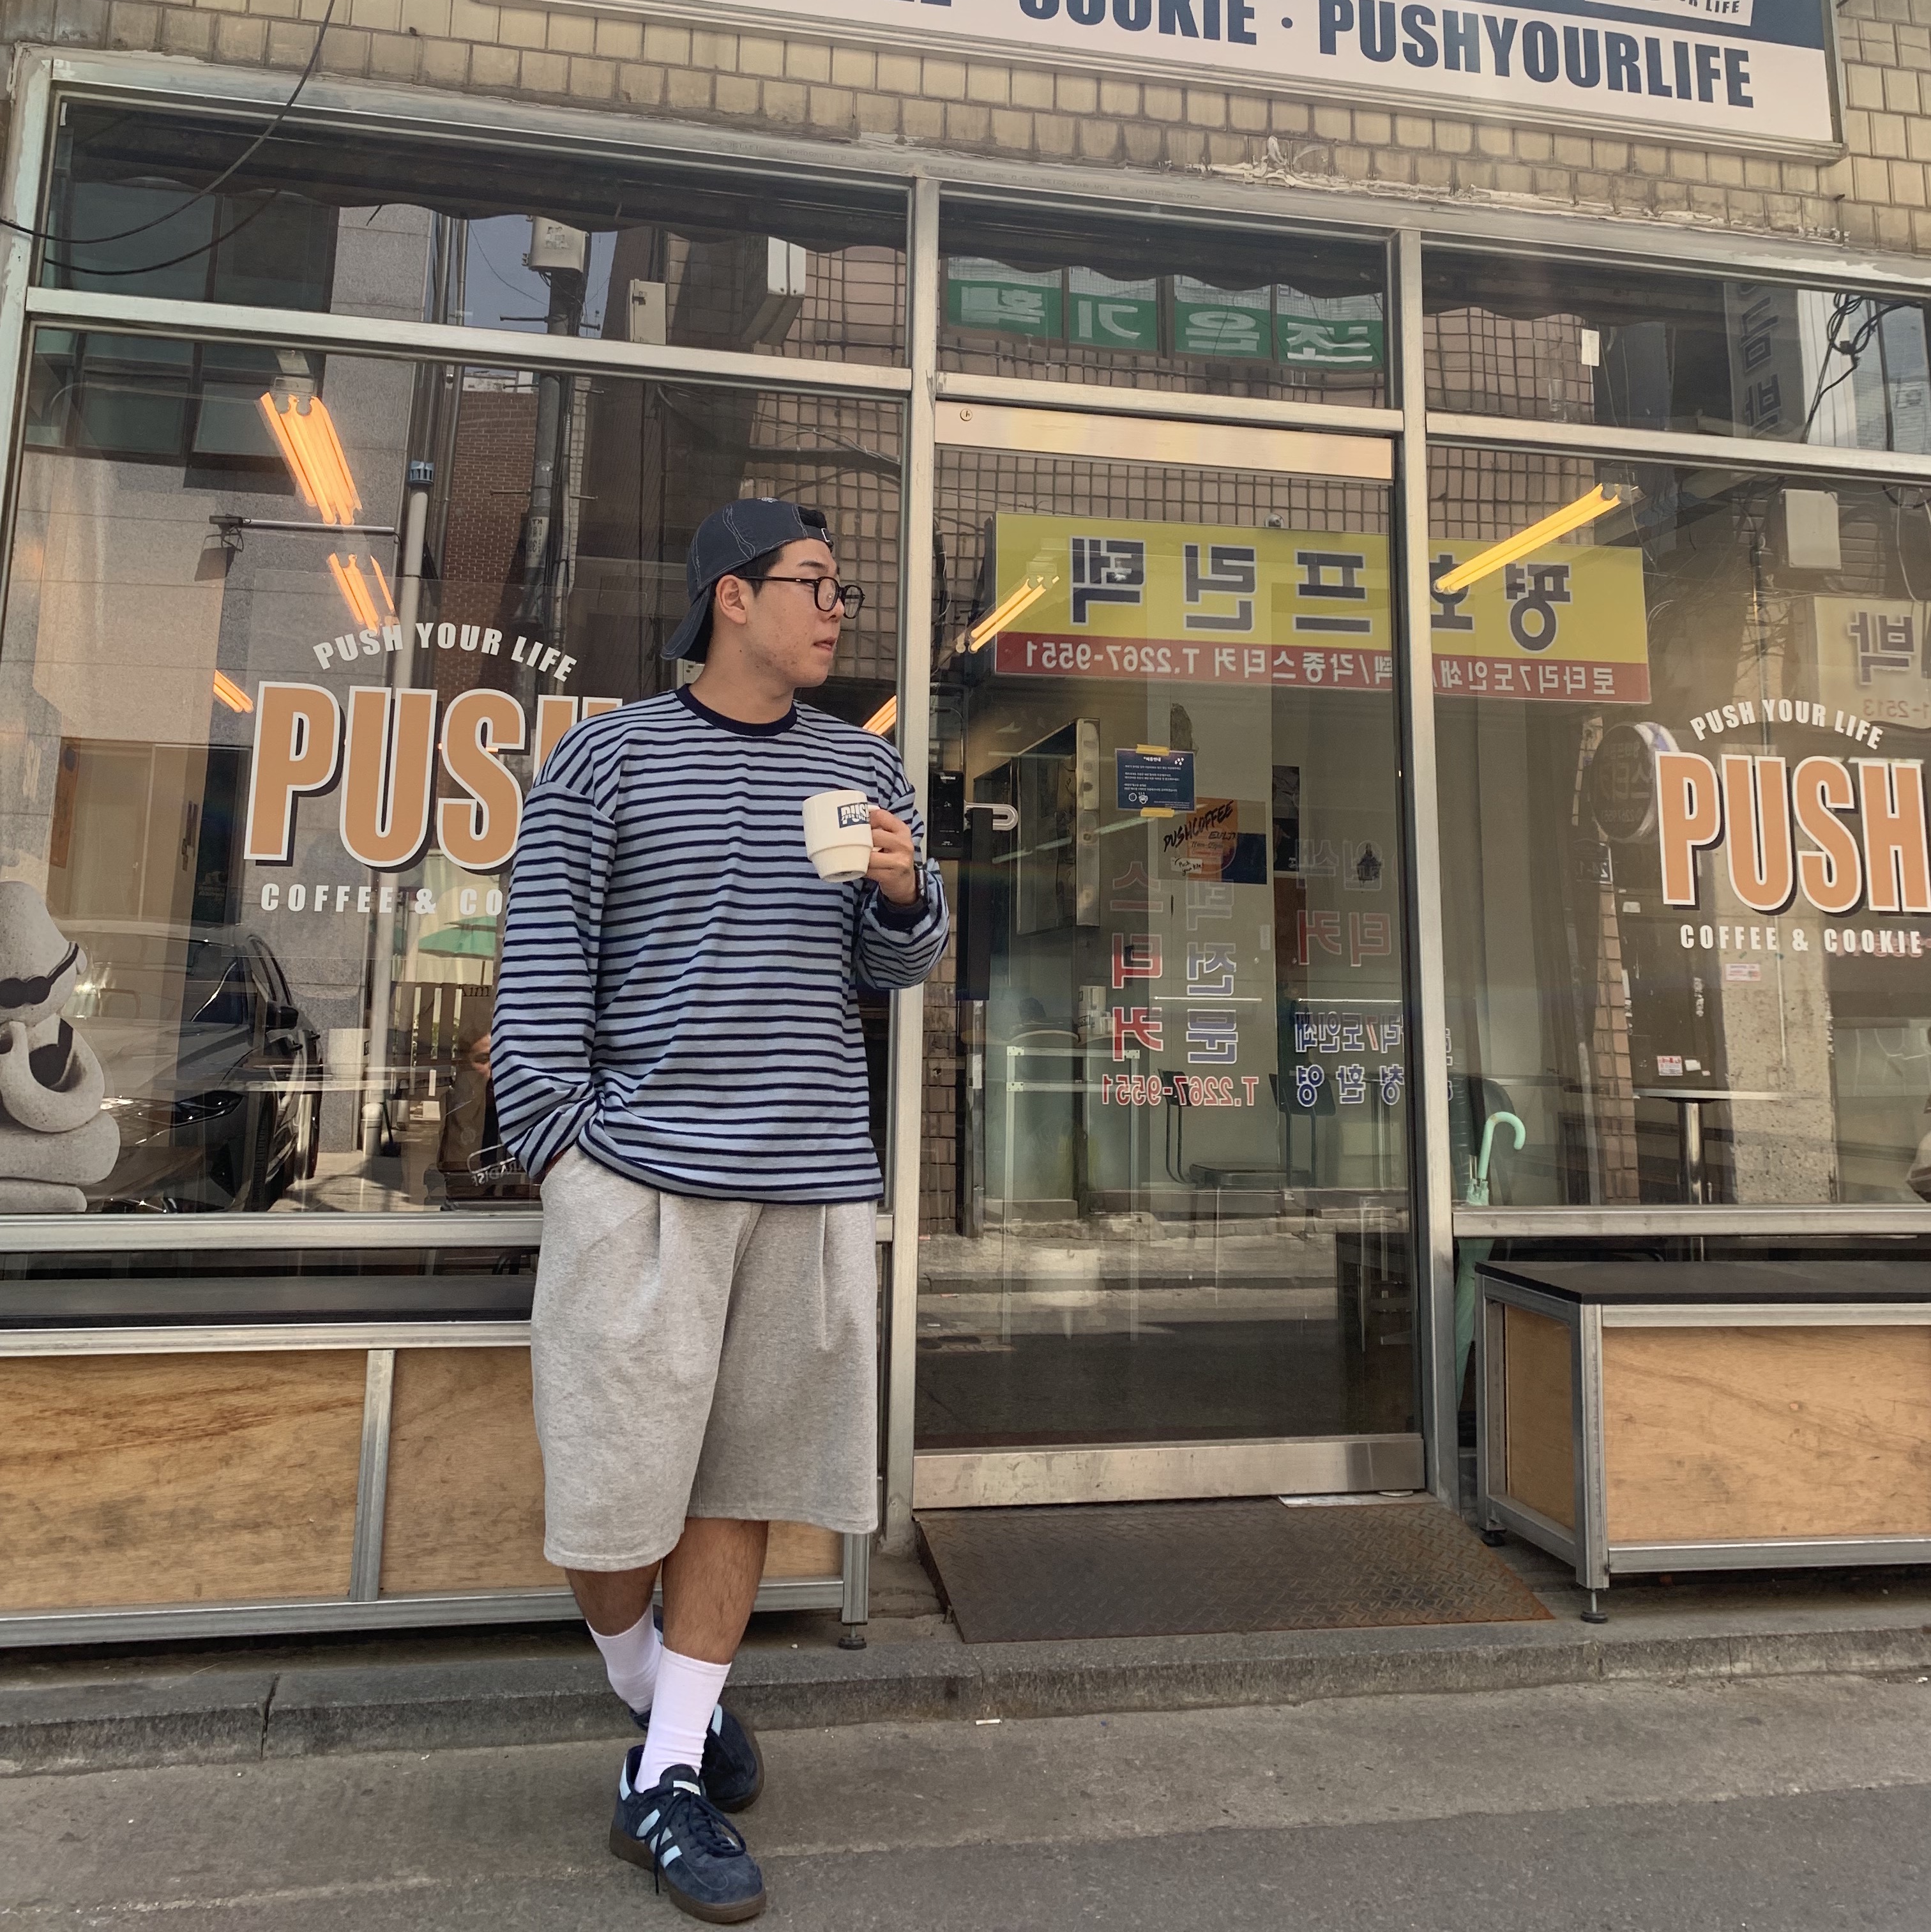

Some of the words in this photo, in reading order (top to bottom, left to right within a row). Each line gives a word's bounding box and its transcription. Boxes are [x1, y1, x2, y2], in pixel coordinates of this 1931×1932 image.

[1706, 0, 1740, 13] LIFE
[1319, 0, 1754, 109] PUSHYOURLIFE
[313, 623, 404, 670] PUSH
[416, 622, 503, 656] YOUR
[511, 636, 577, 682] LIFE
[1690, 701, 1757, 741] PUSH
[1761, 699, 1826, 727] YOUR
[1834, 710, 1883, 750] LIFE
[1654, 750, 1931, 916] PUSH
[260, 883, 393, 913] COFFEE
[414, 888, 437, 915] &
[1680, 924, 1778, 950] COFFEE
[1791, 928, 1809, 952] &
[1823, 928, 1922, 955] COOKIE
